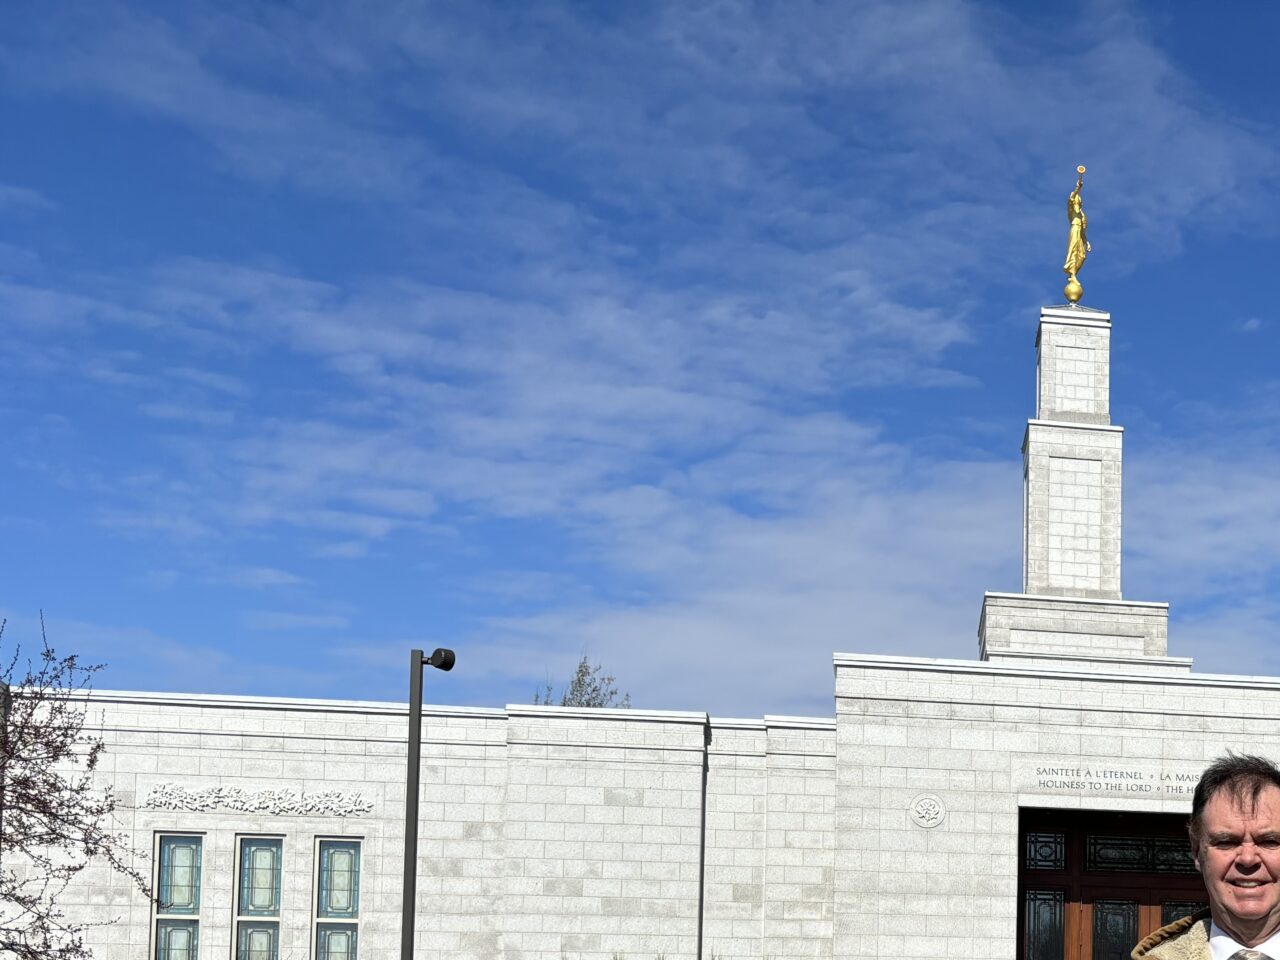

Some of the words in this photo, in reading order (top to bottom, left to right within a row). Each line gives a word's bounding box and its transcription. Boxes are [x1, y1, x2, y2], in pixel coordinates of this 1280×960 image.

[1160, 773, 1171, 781] LA
[1176, 774, 1199, 782] MAIS
[1038, 780, 1085, 790] HOLINESS
[1088, 782, 1102, 790] TO
[1105, 783, 1122, 791] THE
[1126, 783, 1151, 792] LORD
[1165, 785, 1183, 794] THE
